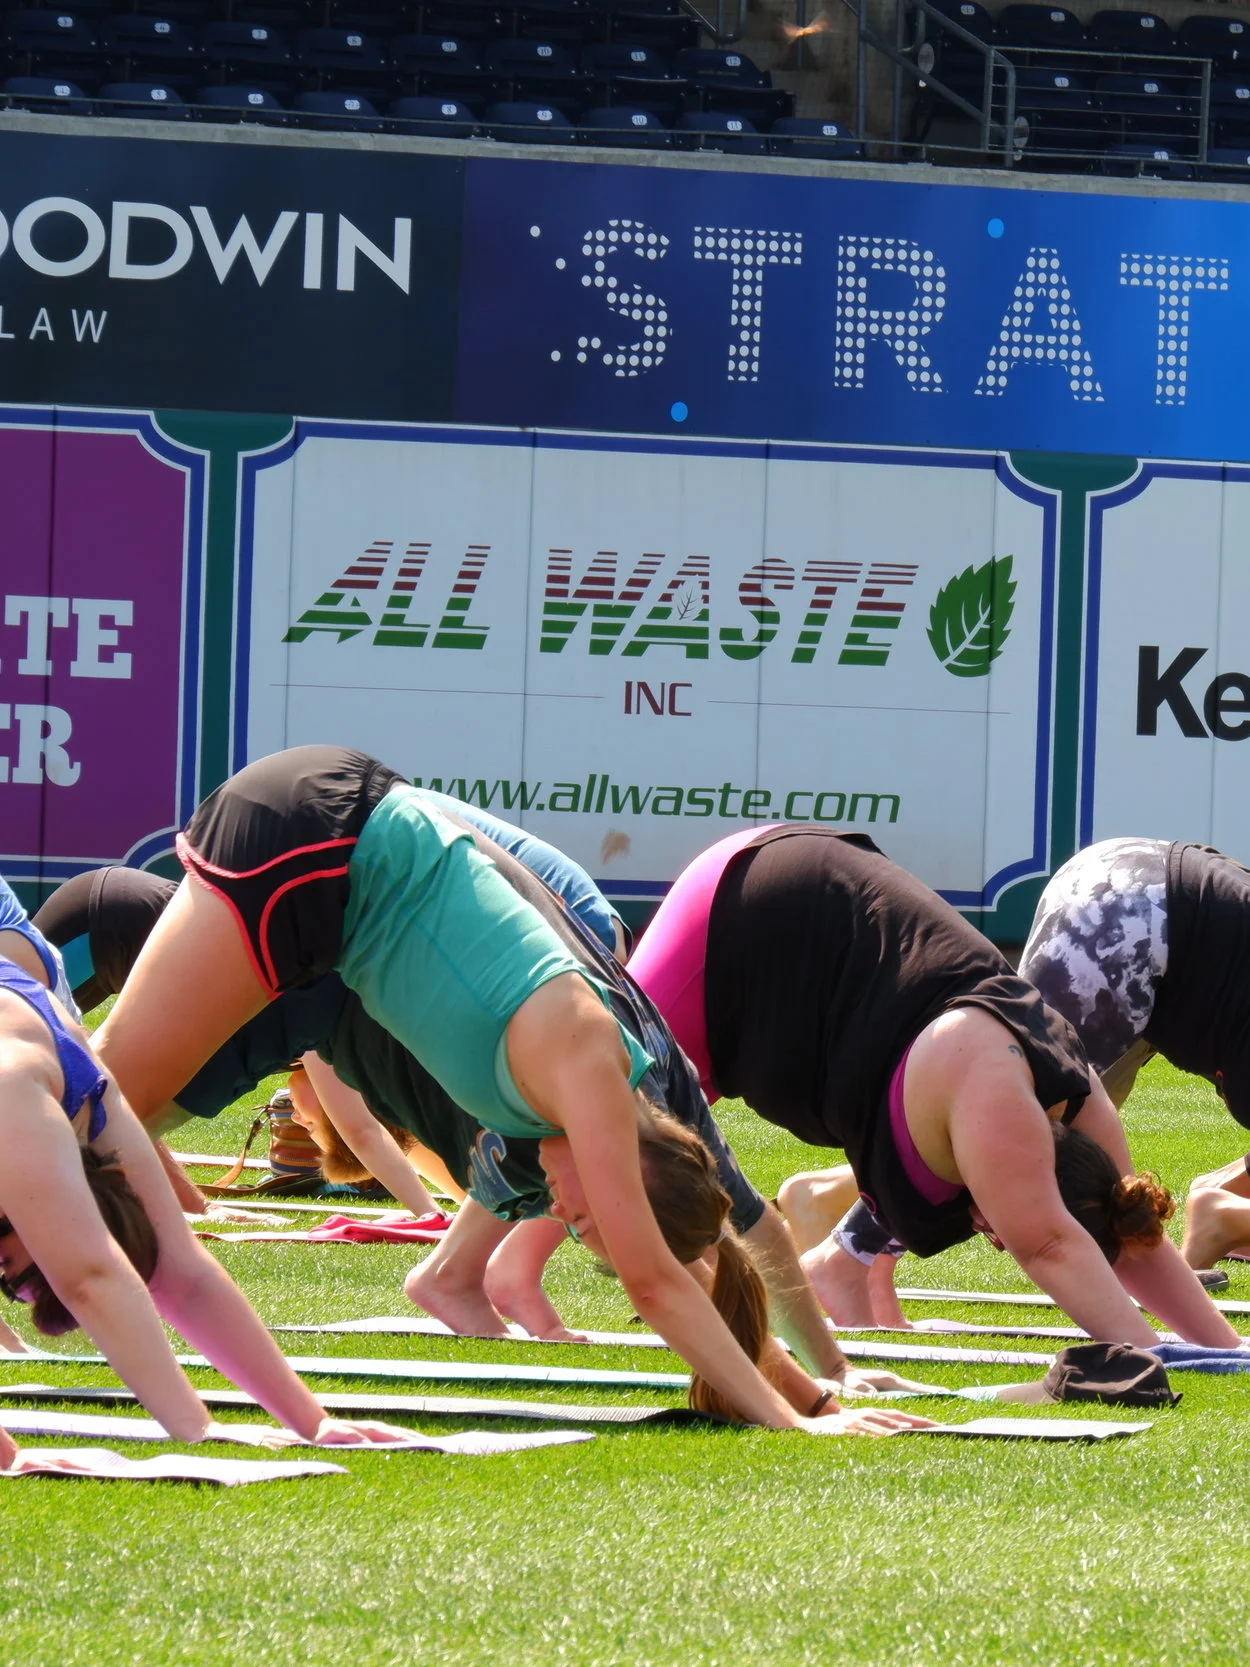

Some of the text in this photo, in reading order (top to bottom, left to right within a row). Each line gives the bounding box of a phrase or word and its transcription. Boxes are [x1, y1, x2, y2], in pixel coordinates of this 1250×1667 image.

[0, 197, 412, 295] ODWIN
[0, 305, 107, 343] LAW
[0, 595, 133, 679] TE
[281, 541, 919, 666] ALL WASTE
[622, 681, 693, 717] INC
[0, 703, 81, 786] R
